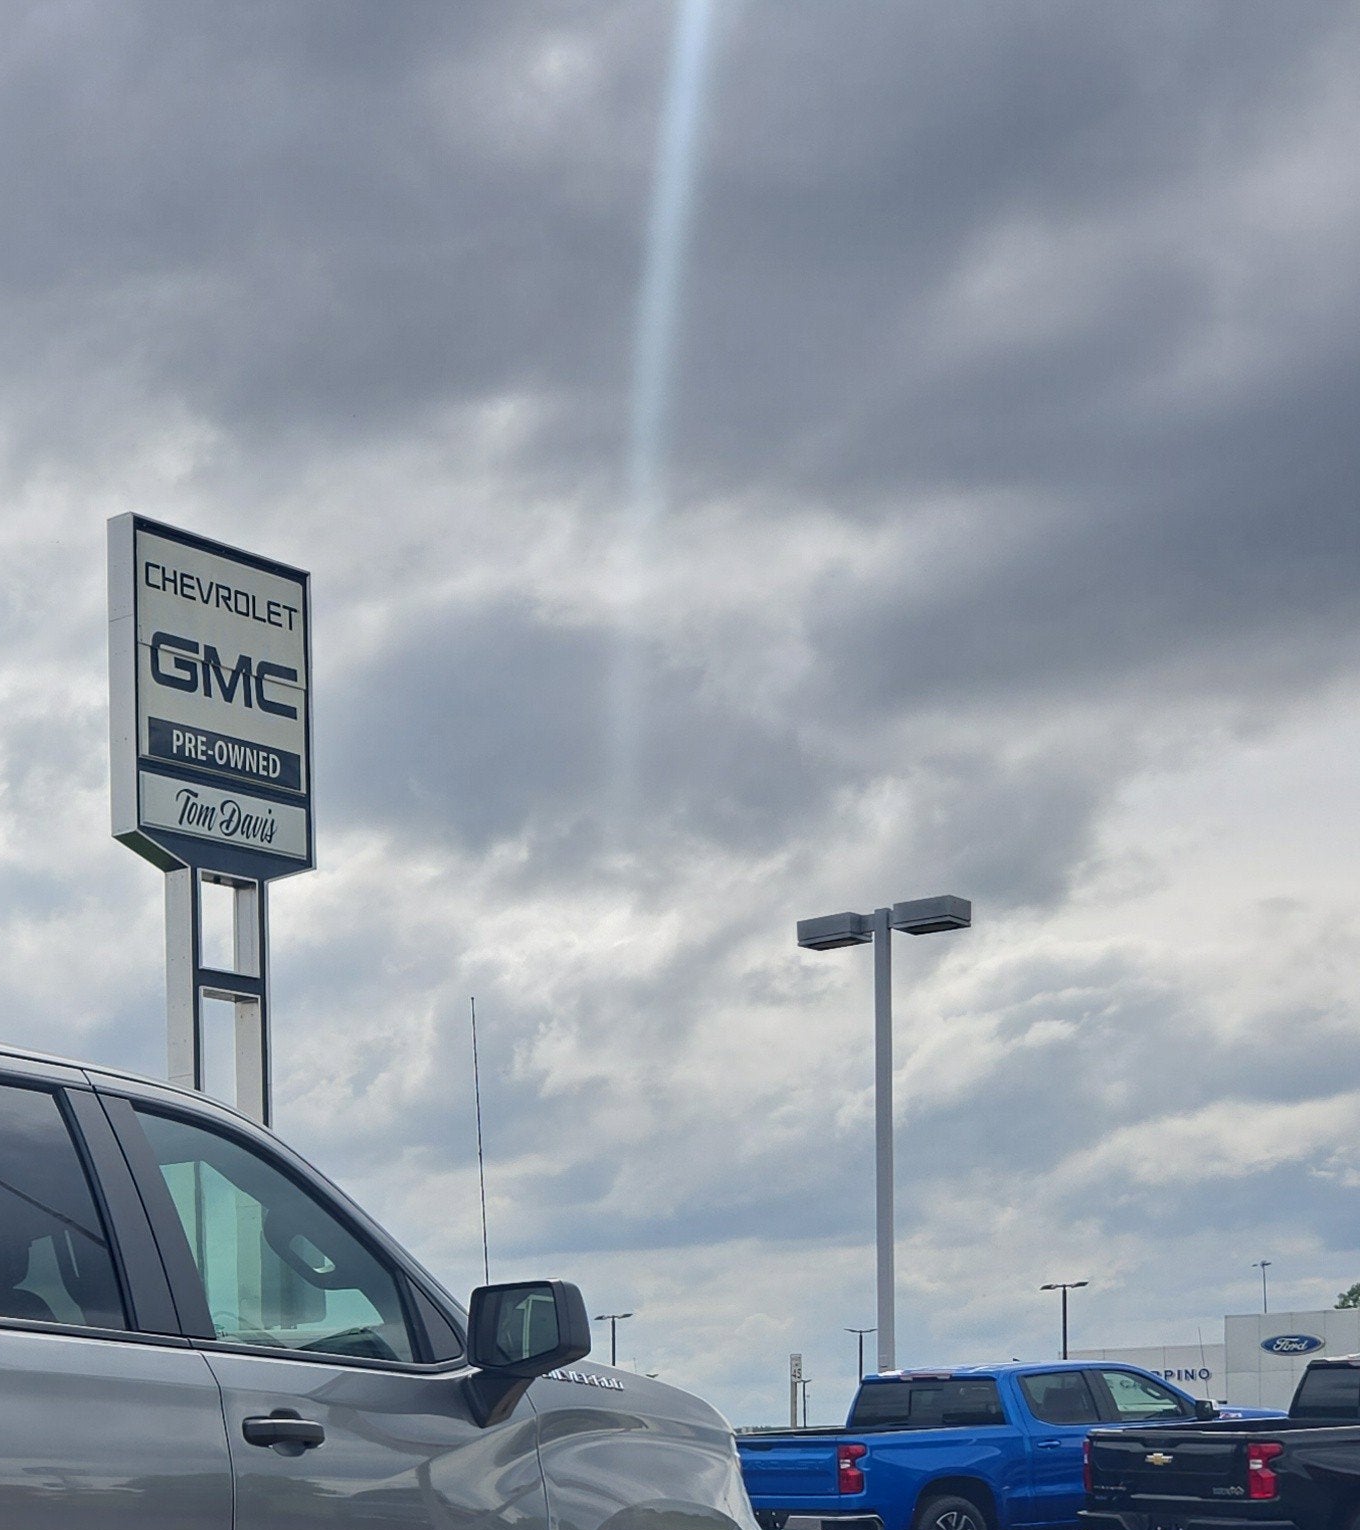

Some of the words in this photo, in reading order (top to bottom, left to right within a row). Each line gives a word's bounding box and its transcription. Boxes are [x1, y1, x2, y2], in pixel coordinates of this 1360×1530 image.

[144, 561, 298, 631] CHEVROLET
[150, 630, 298, 721] GMC
[171, 728, 281, 780] PRE-OWNED
[175, 787, 217, 832] Tom
[218, 799, 278, 845] Davis
